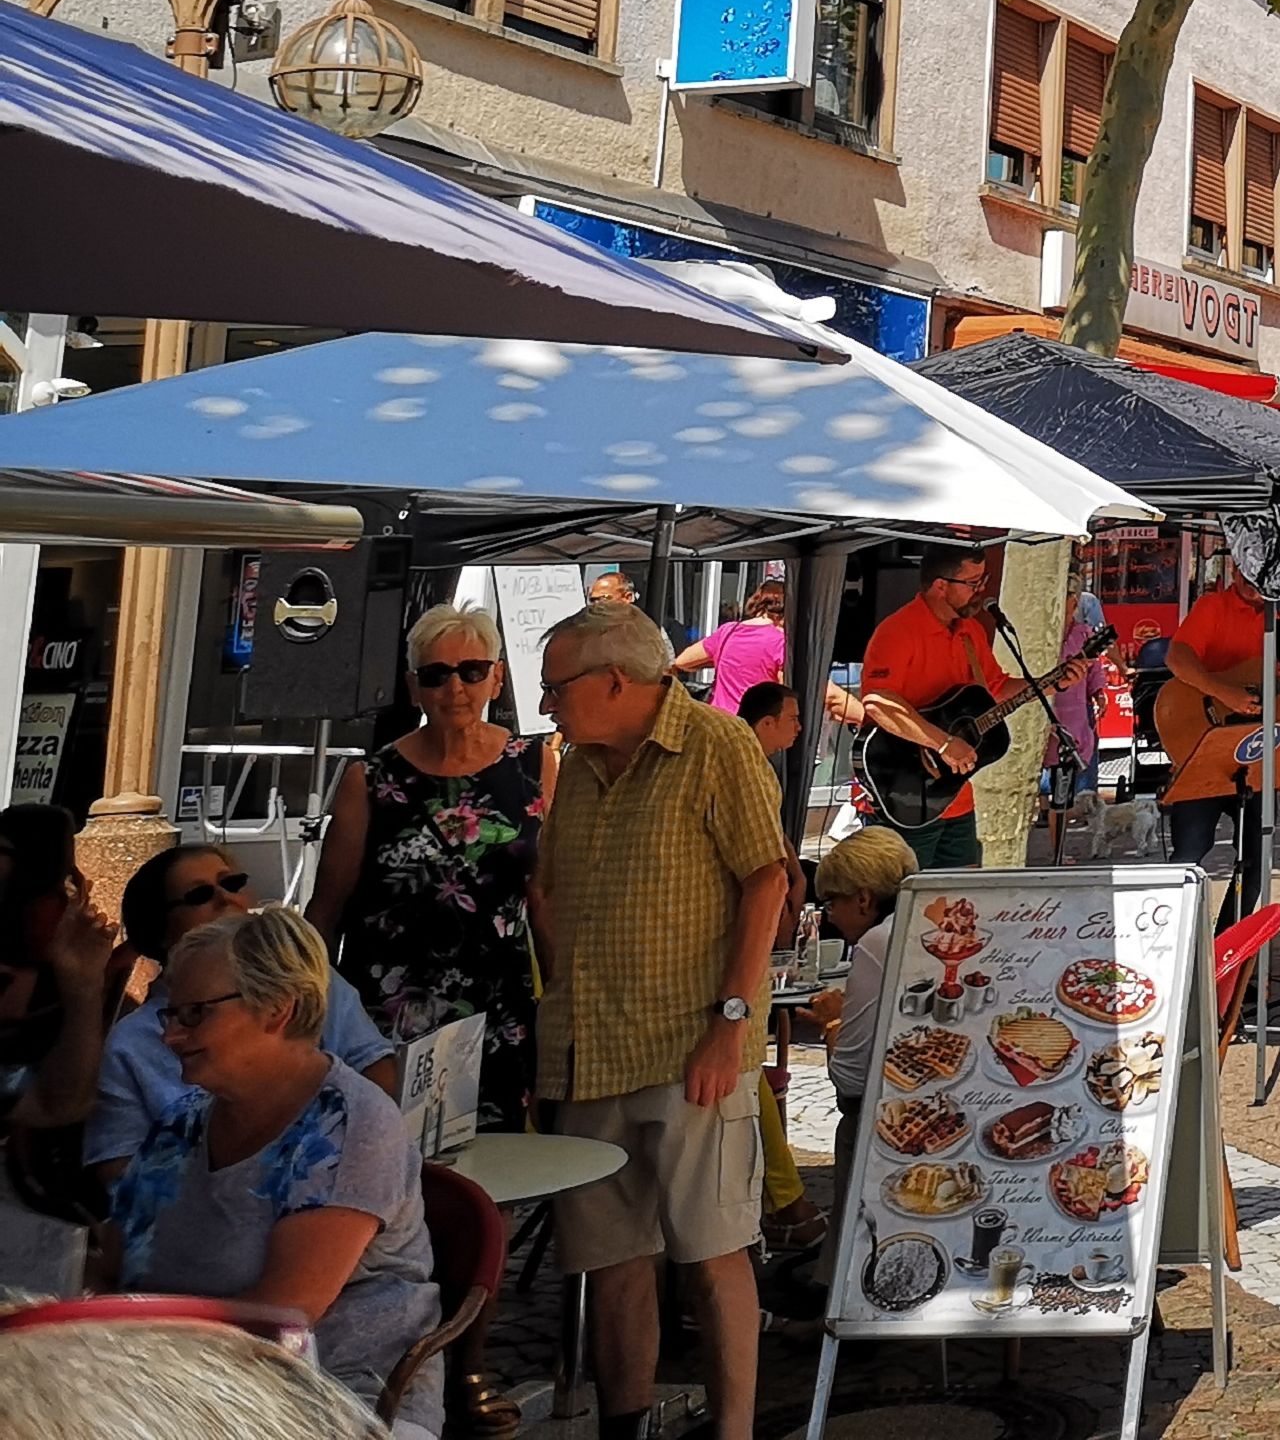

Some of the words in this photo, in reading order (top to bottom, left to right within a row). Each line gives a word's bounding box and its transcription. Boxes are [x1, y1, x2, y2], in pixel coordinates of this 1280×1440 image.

[1131, 263, 1179, 304] GEREI
[1180, 276, 1258, 348] VOGT
[21, 702, 66, 728] tion
[17, 735, 60, 756] zza
[14, 762, 54, 789] herita
[988, 897, 1061, 923] nicht
[1021, 925, 1068, 940] nur
[416, 1047, 435, 1078] EIS
[960, 1090, 1014, 1111] Waffeln
